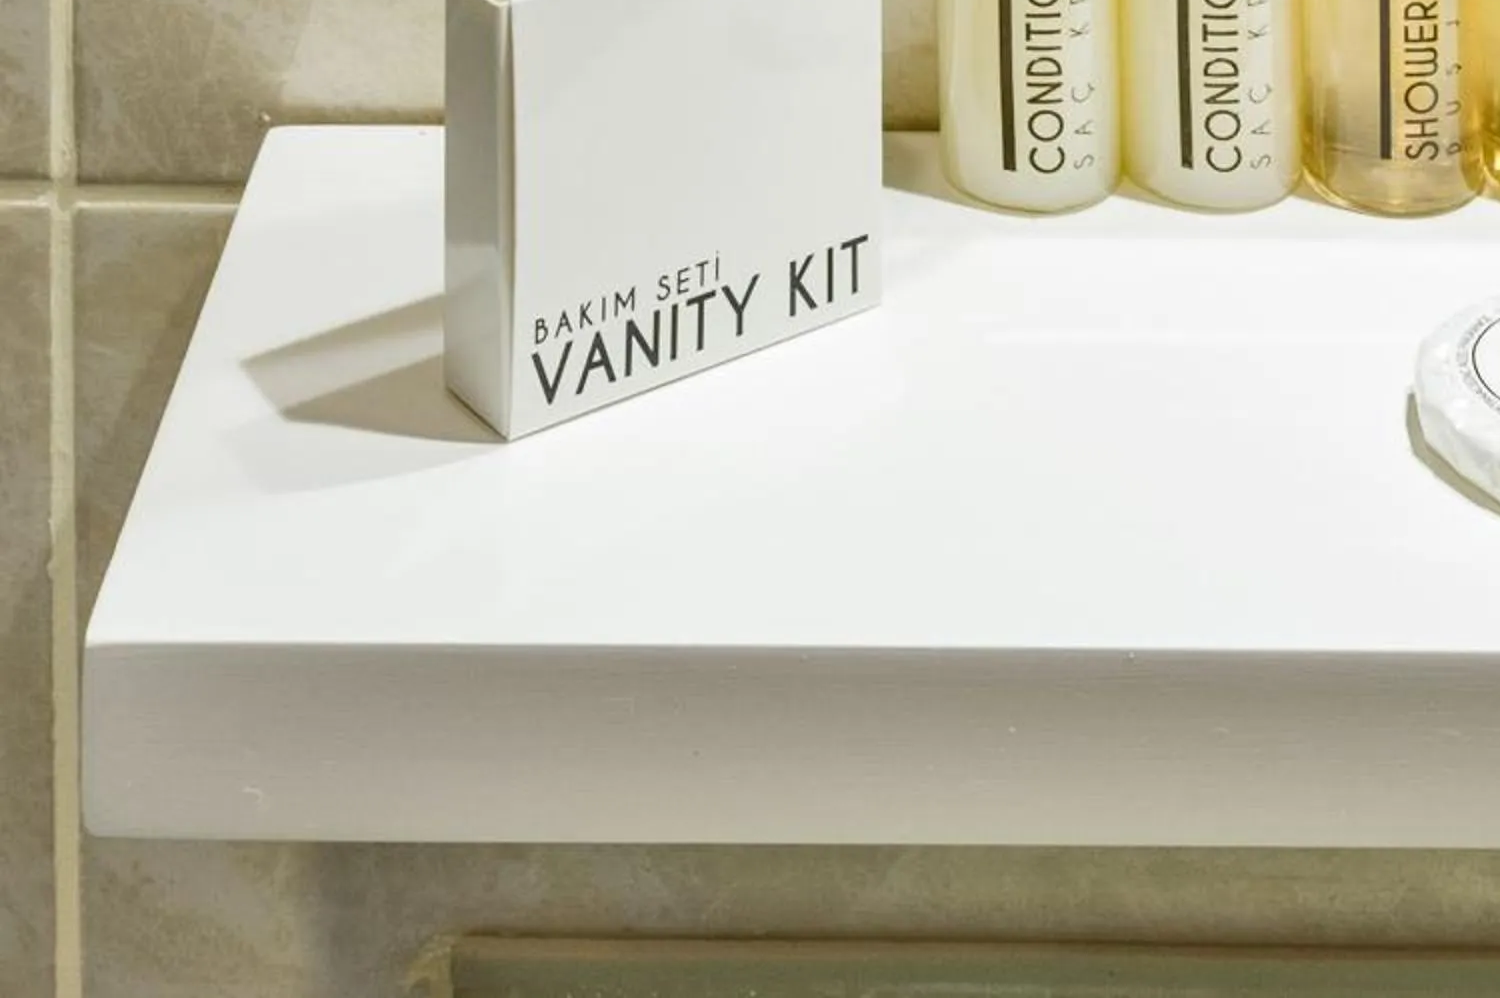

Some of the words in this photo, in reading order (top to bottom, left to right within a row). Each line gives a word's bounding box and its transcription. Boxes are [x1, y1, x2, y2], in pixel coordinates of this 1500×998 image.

[1070, 84, 1094, 169] SAÇ
[1249, 84, 1272, 169] SAÇ
[1404, 0, 1439, 162] SHOWER
[531, 274, 760, 404] VANITY
[789, 234, 868, 316] KIT
[534, 287, 636, 344] BAKIM
[657, 251, 720, 300] SETİ
